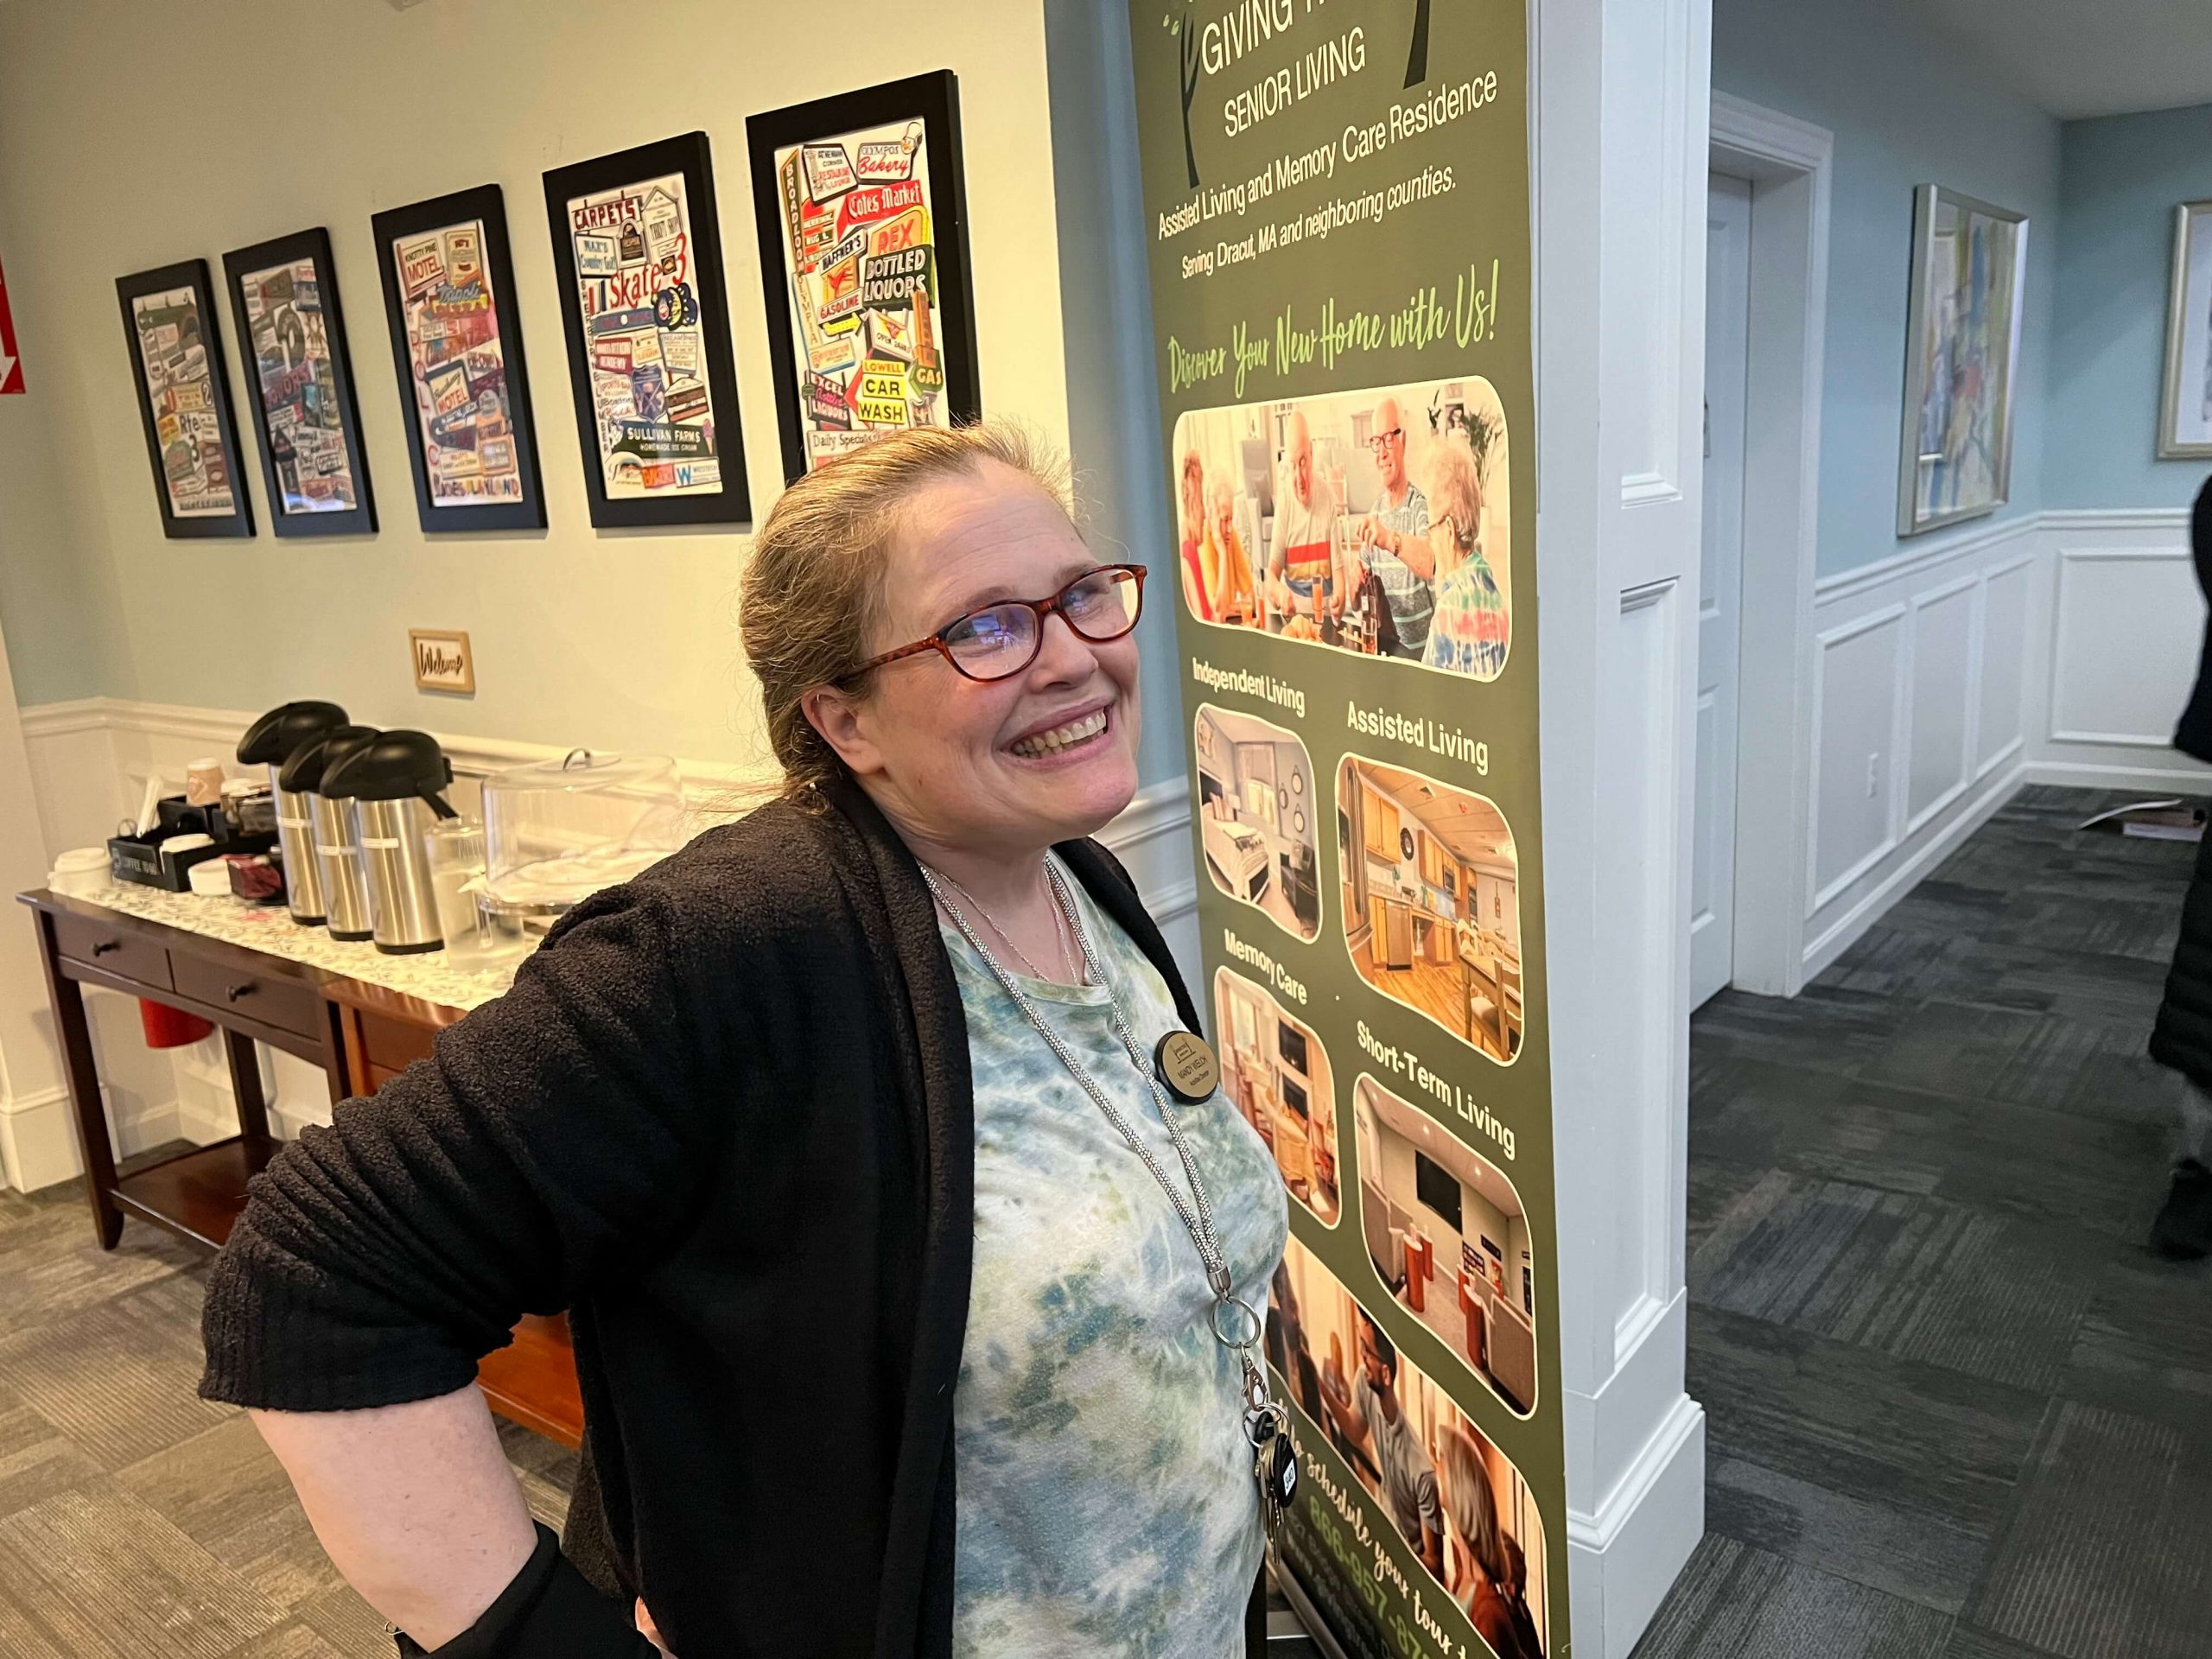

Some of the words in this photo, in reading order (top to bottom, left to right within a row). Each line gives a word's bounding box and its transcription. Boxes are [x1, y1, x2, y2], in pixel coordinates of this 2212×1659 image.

[1202, 0, 1294, 75] GIVING
[1224, 68, 1293, 137] SENIOR
[1295, 26, 1367, 101] LIVING
[858, 156, 910, 176] Bakery
[1159, 194, 1200, 240] Assisted
[1202, 182, 1245, 216] Living
[1247, 162, 1273, 204] and
[1275, 141, 1337, 191] Memory
[1342, 122, 1387, 162] Care
[1389, 70, 1497, 144] Residence
[882, 184, 921, 210] Market
[575, 199, 637, 230] CARPETS
[1217, 233, 1256, 268] Dracut,
[1258, 223, 1278, 254] MA
[1280, 213, 1303, 247] and
[1305, 190, 1384, 239] neighboring
[1387, 165, 1457, 211] counties.
[877, 219, 914, 254] REX
[407, 255, 441, 281] MOTEL
[866, 249, 926, 279] BOTTLED
[609, 264, 663, 308] Skate
[864, 274, 926, 302] LIQUORS
[820, 295, 861, 319] GASOLINE
[1167, 335, 1227, 394] Discover
[1276, 304, 1319, 376] New
[1319, 297, 1386, 370] Home
[1390, 287, 1451, 350] with
[1455, 259, 1499, 349] Us!
[864, 362, 901, 373] LOWELL
[916, 368, 942, 385] GAS
[810, 373, 844, 396] EXCEL
[865, 379, 900, 396] CAR
[860, 402, 903, 421] WASH
[627, 427, 672, 442] SULLIVAN
[812, 435, 836, 450] Daily
[1192, 657, 1265, 699] Independent
[1266, 677, 1306, 719] Living
[1347, 701, 1425, 748] Assisted
[1428, 720, 1490, 777] Living
[1224, 928, 1276, 986] Memory
[1275, 963, 1308, 1006] Care
[1357, 1020, 1452, 1108] Short-Term
[1455, 1086, 1516, 1161] Living
[1306, 1452, 1372, 1548] schedule
[1373, 1541, 1410, 1599] your
[1413, 1589, 1453, 1656] tour
[1309, 1494, 1430, 1659] 866-957-87
